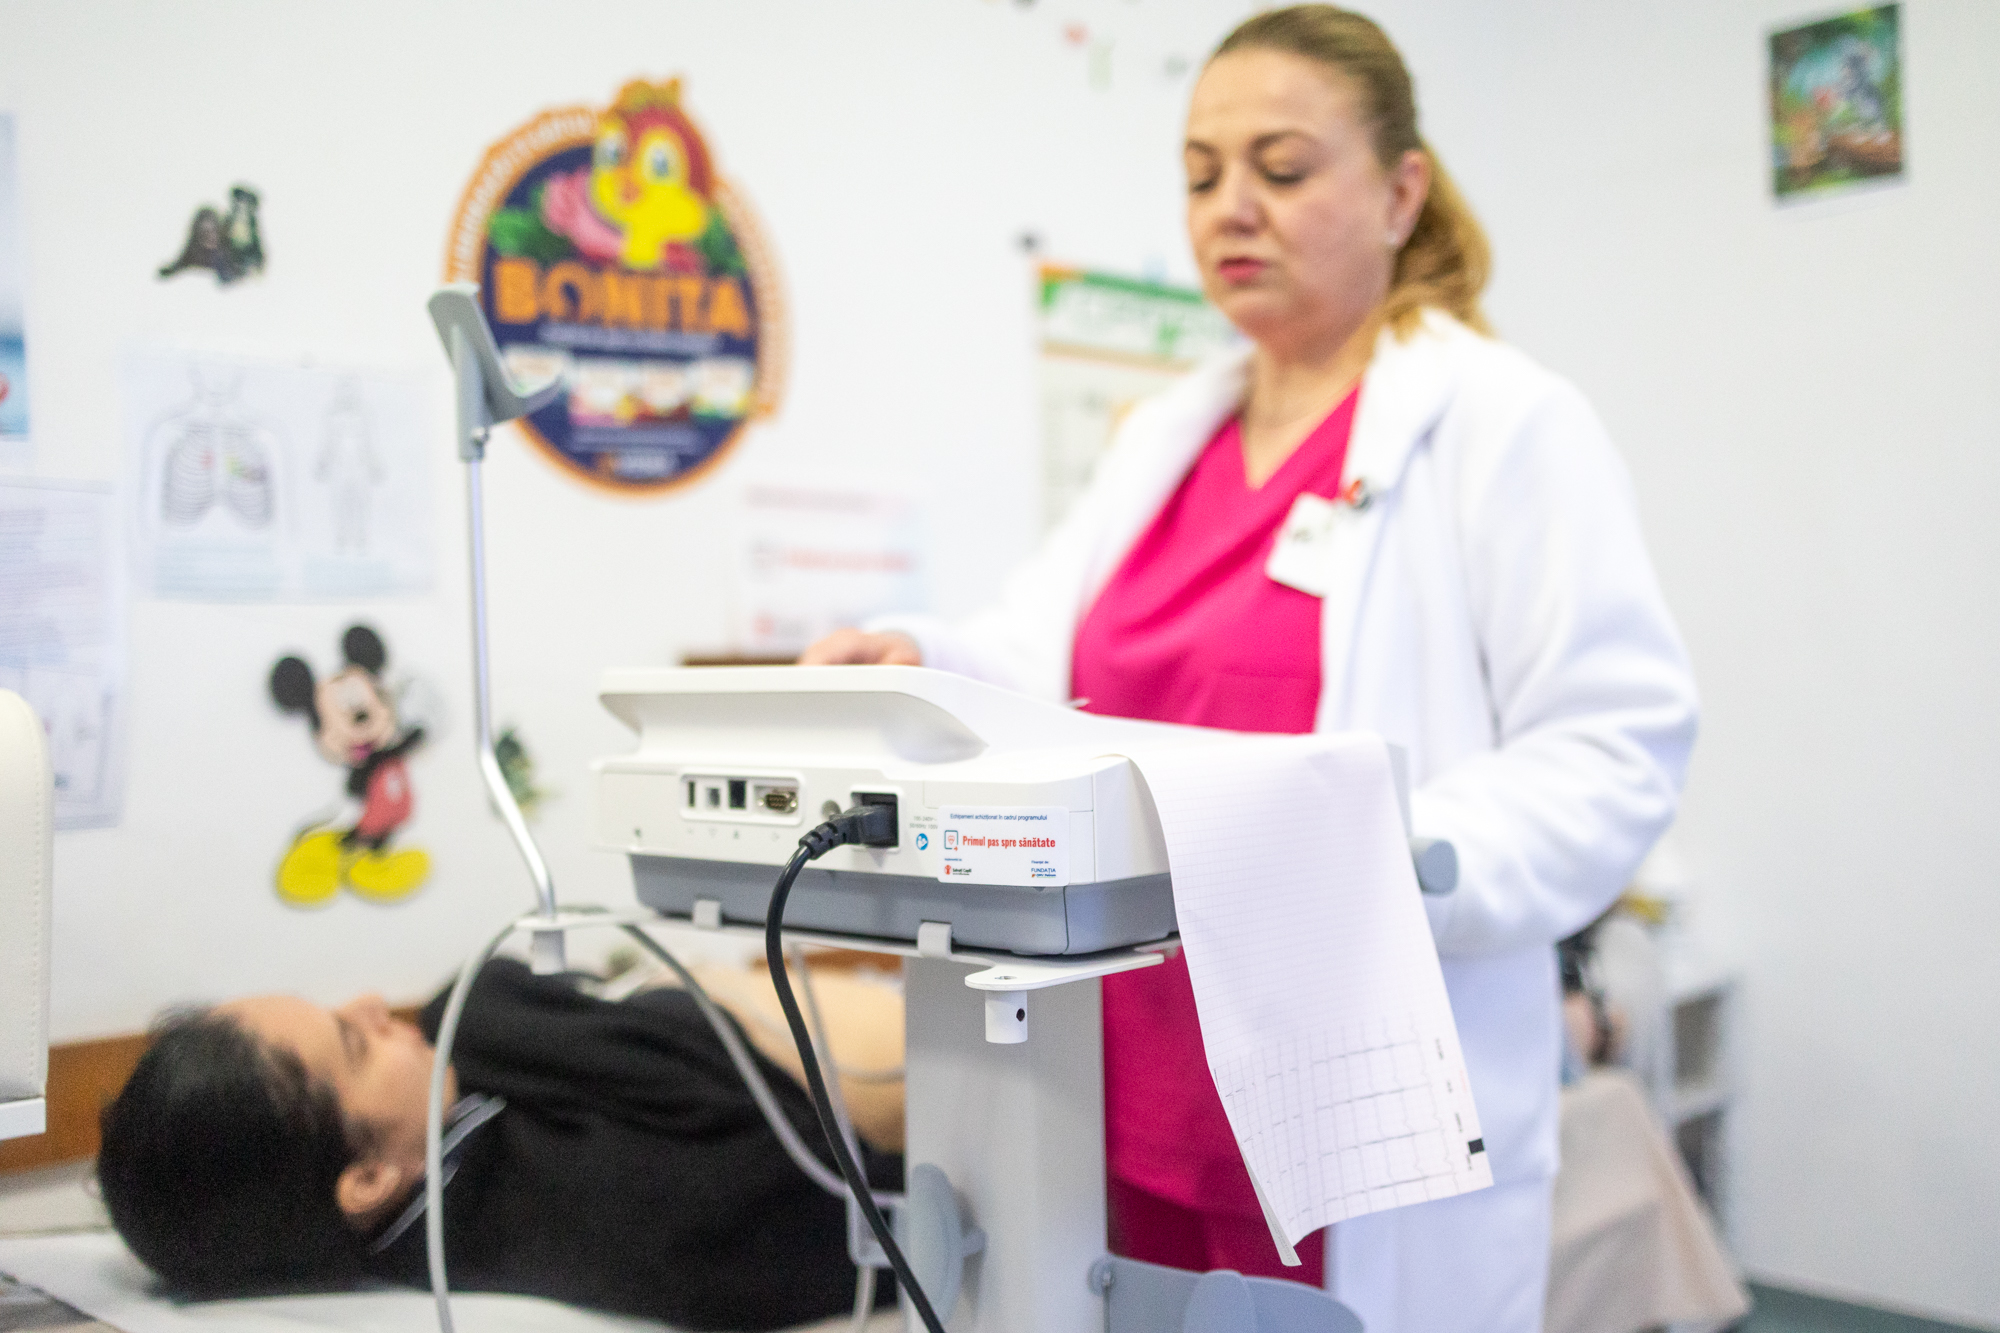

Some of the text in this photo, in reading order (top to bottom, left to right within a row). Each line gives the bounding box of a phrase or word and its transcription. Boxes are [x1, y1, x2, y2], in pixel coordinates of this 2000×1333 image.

[496, 259, 750, 338] BONITA
[962, 836, 1056, 849] Primul pas spre sănătate
